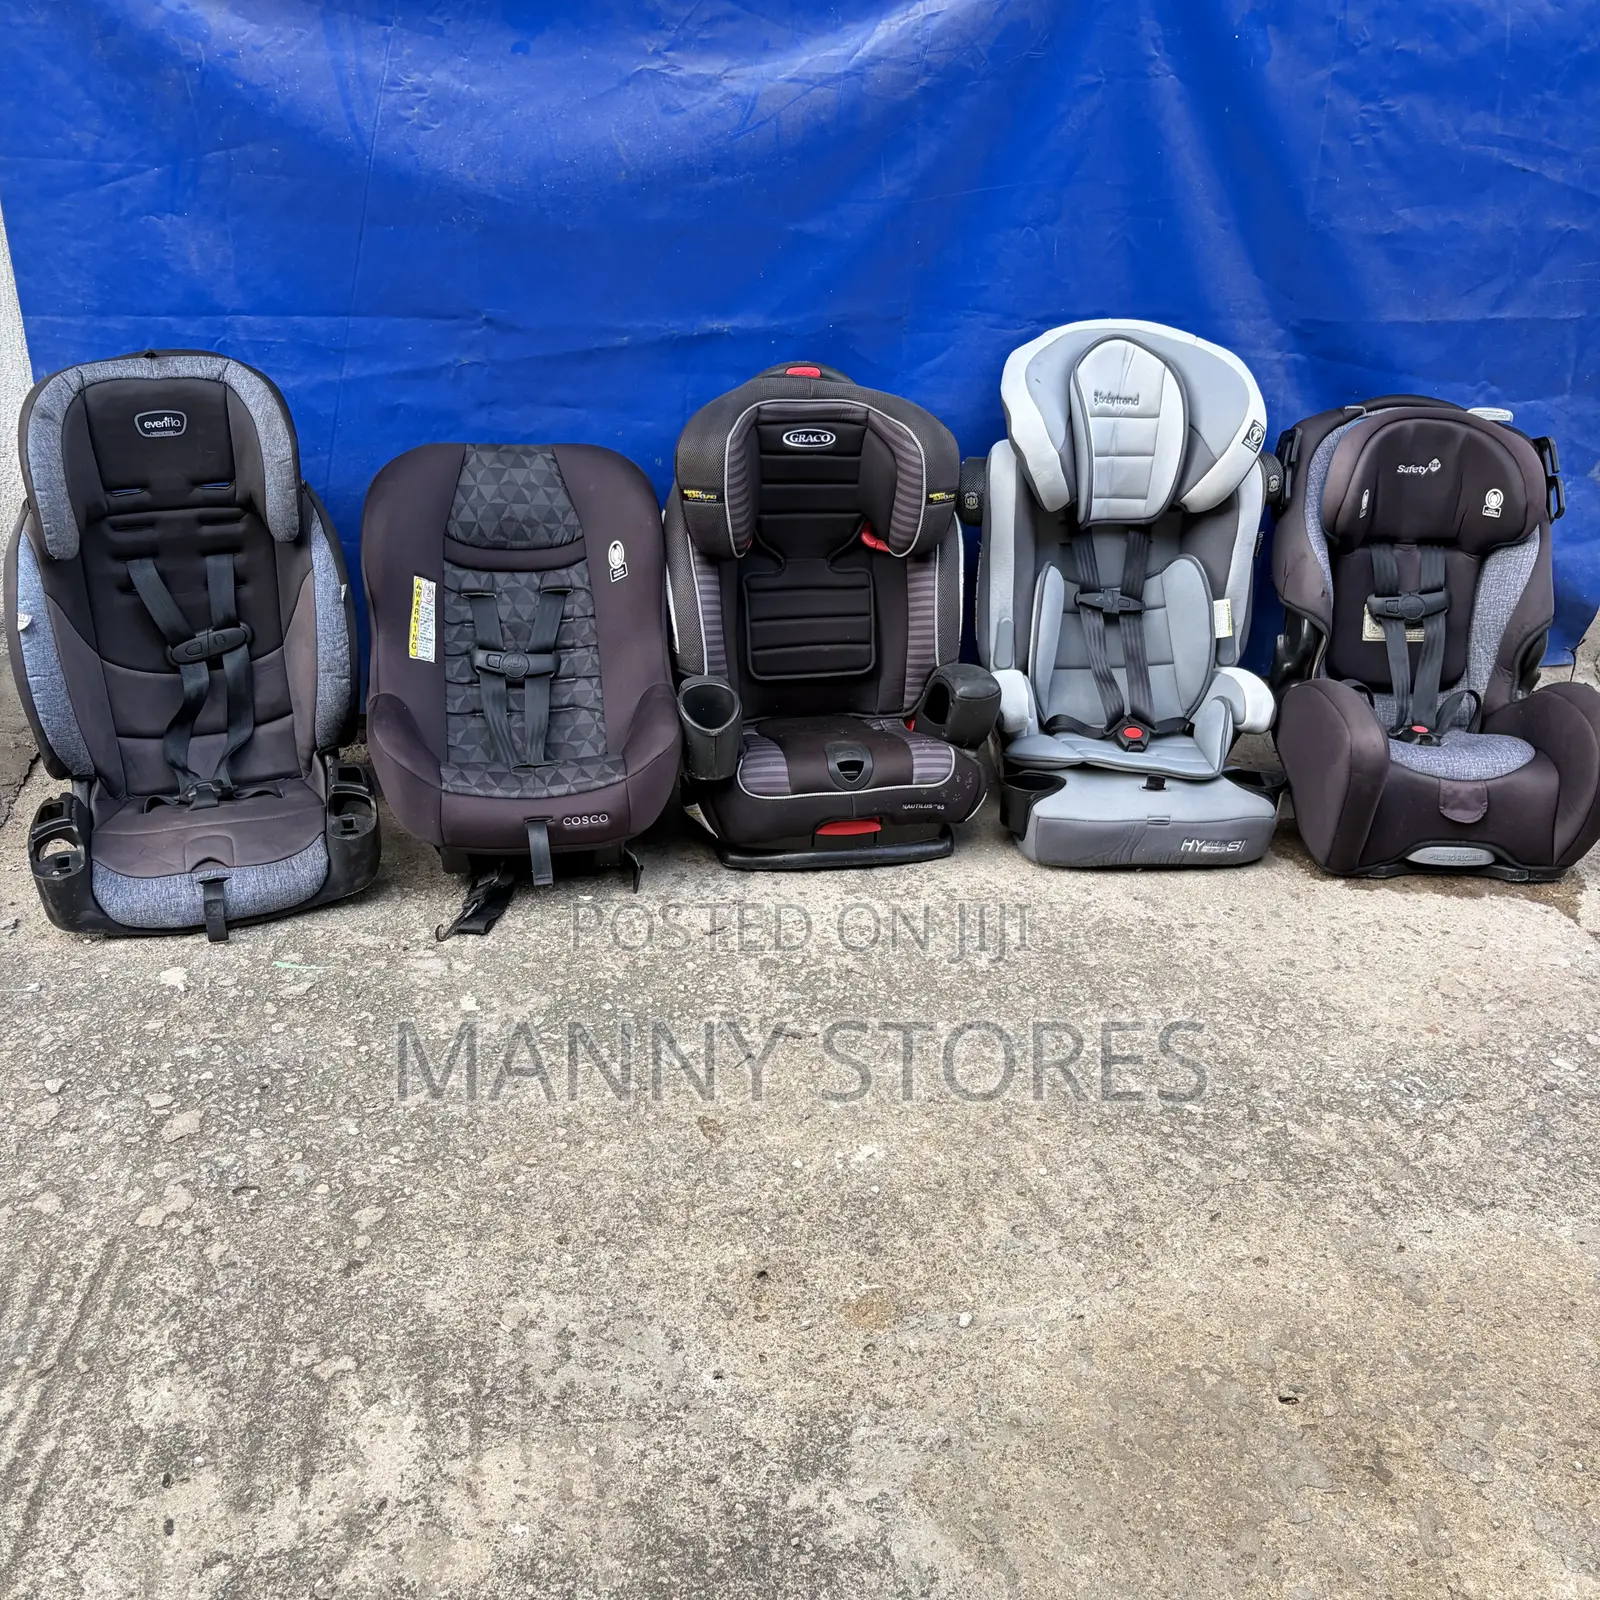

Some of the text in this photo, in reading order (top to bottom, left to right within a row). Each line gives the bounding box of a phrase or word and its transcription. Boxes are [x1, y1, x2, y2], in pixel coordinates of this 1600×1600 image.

[144, 416, 181, 429] evenflo
[789, 433, 831, 443] GRACO
[1396, 464, 1429, 475] Safety
[411, 590, 421, 650] WARNING
[562, 813, 609, 826] COSCO
